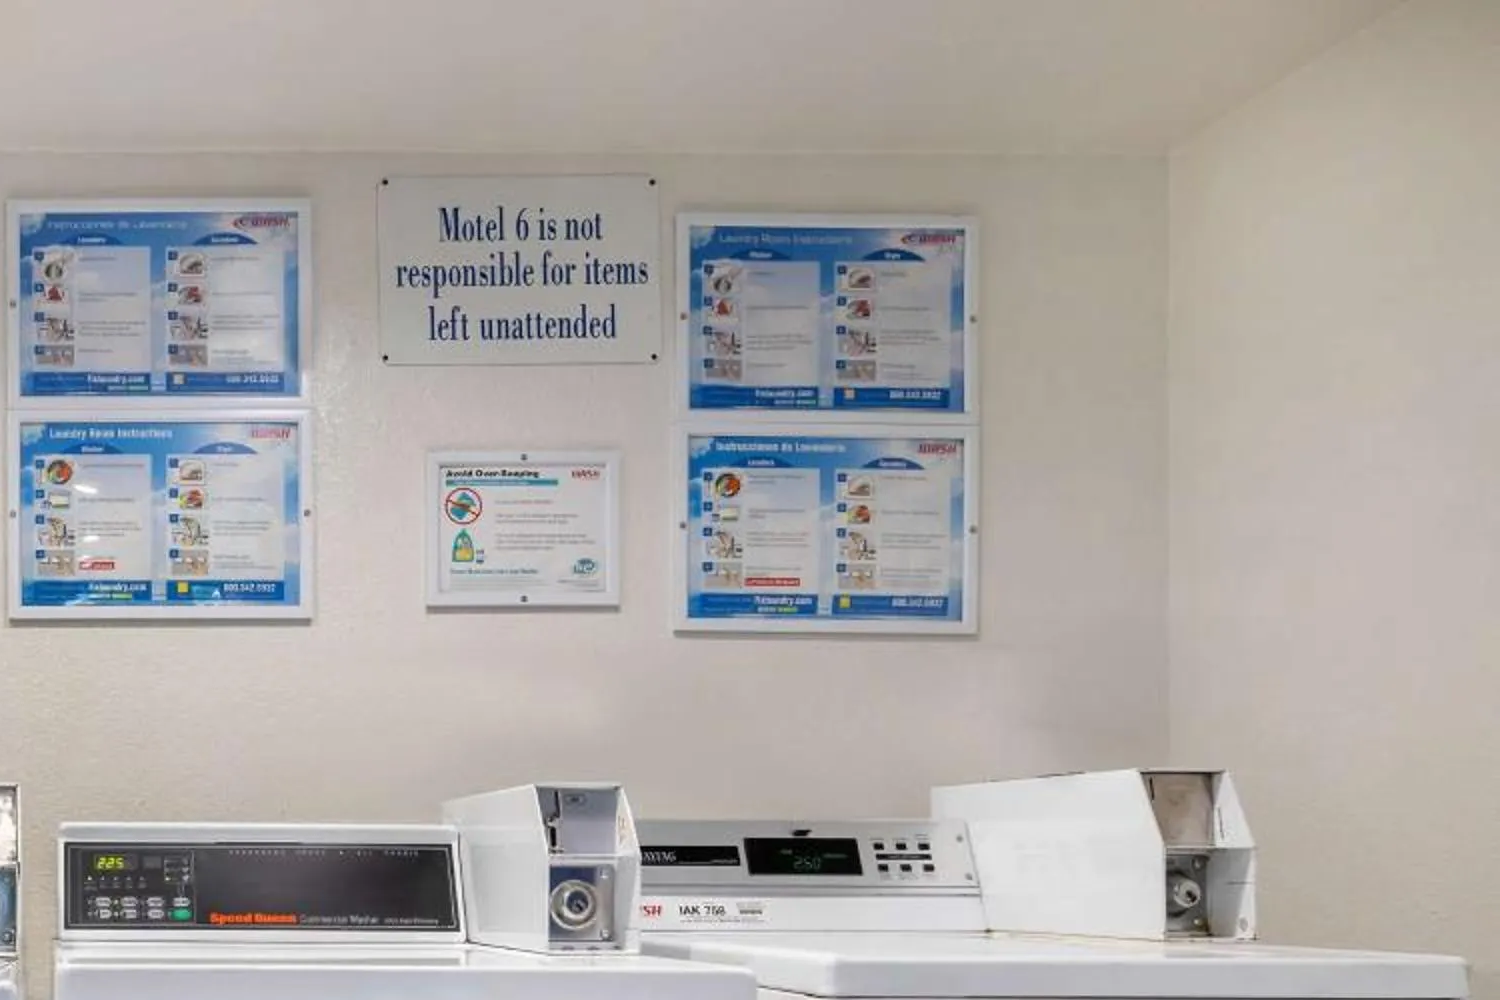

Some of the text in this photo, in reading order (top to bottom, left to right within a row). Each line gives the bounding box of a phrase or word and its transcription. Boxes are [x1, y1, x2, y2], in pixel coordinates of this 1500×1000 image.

[439, 206, 603, 242] Motel 6 is not
[396, 250, 649, 298] responsible for items
[428, 303, 617, 341] left unattended
[97, 856, 125, 870] 225
